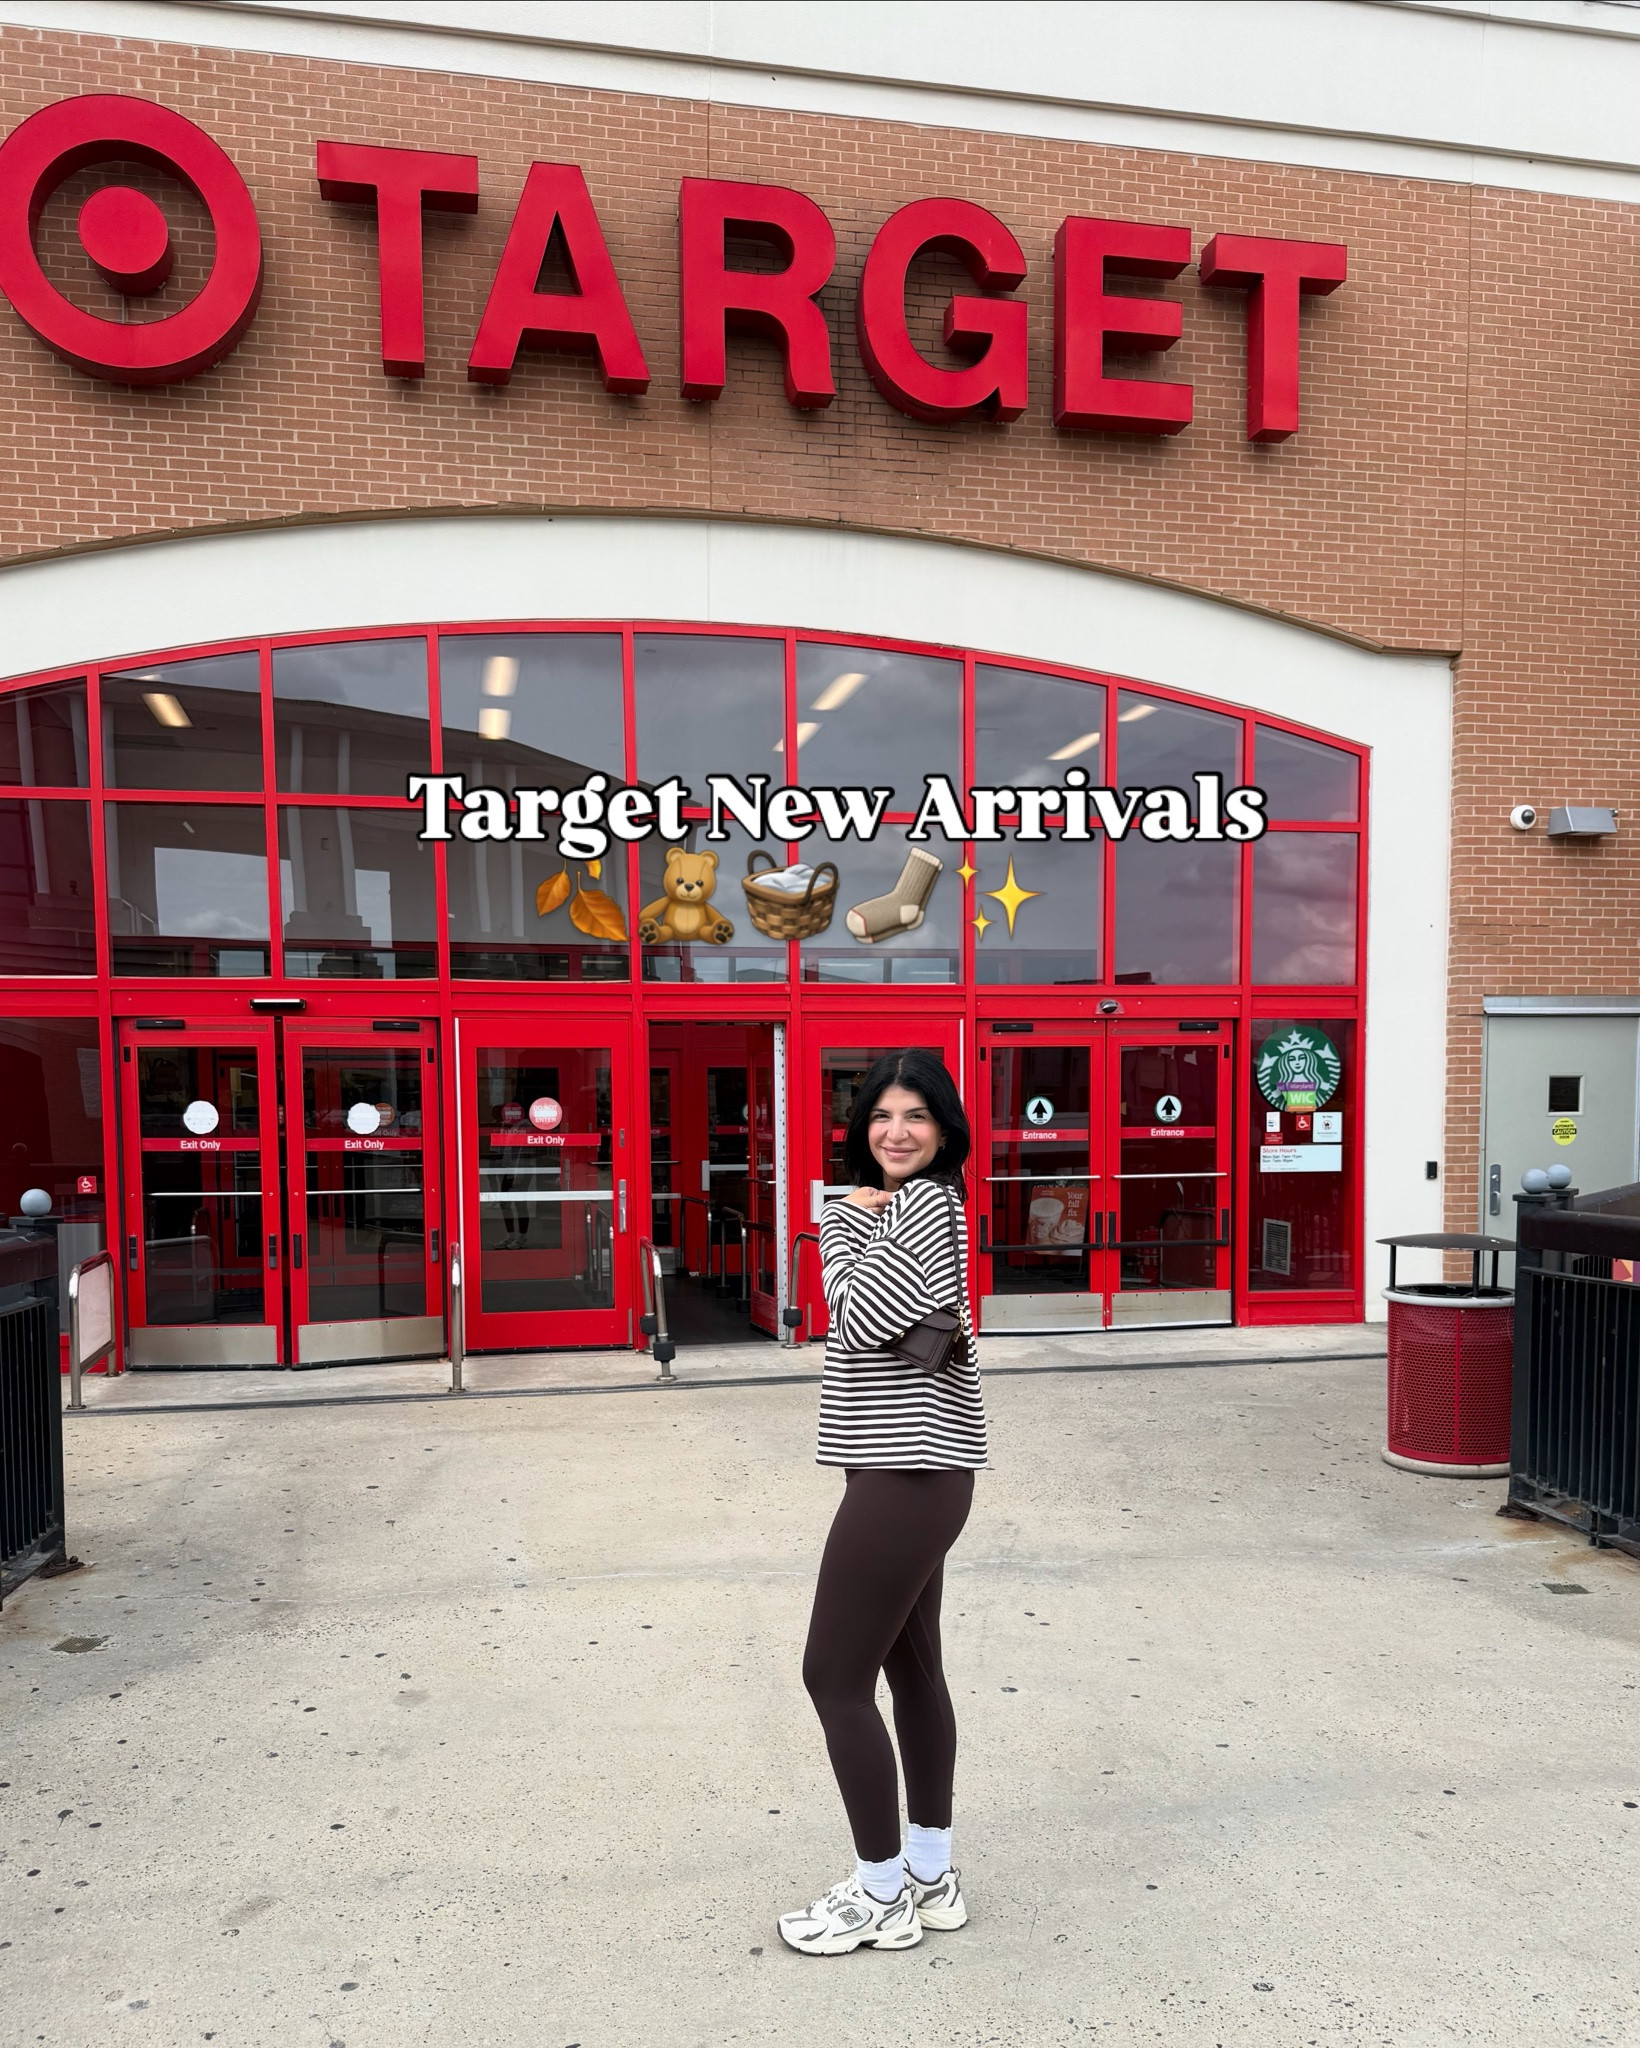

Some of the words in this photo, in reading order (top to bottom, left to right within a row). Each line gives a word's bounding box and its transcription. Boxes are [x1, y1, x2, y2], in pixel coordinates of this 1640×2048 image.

[317, 139, 1346, 443] TARGET
[1289, 1093, 1314, 1104] WIC
[1023, 1131, 1057, 1140] Entrance
[1150, 1128, 1185, 1137] Entrance
[180, 1140, 198, 1150] Exit
[199, 1140, 221, 1151] Only
[344, 1140, 362, 1149] Exit
[363, 1139, 385, 1151] Only
[527, 1136, 544, 1145] Exit
[545, 1135, 566, 1146] Only
[1067, 1191, 1083, 1200] Your
[1067, 1200, 1080, 1208] fall
[1067, 1209, 1078, 1217] fix
